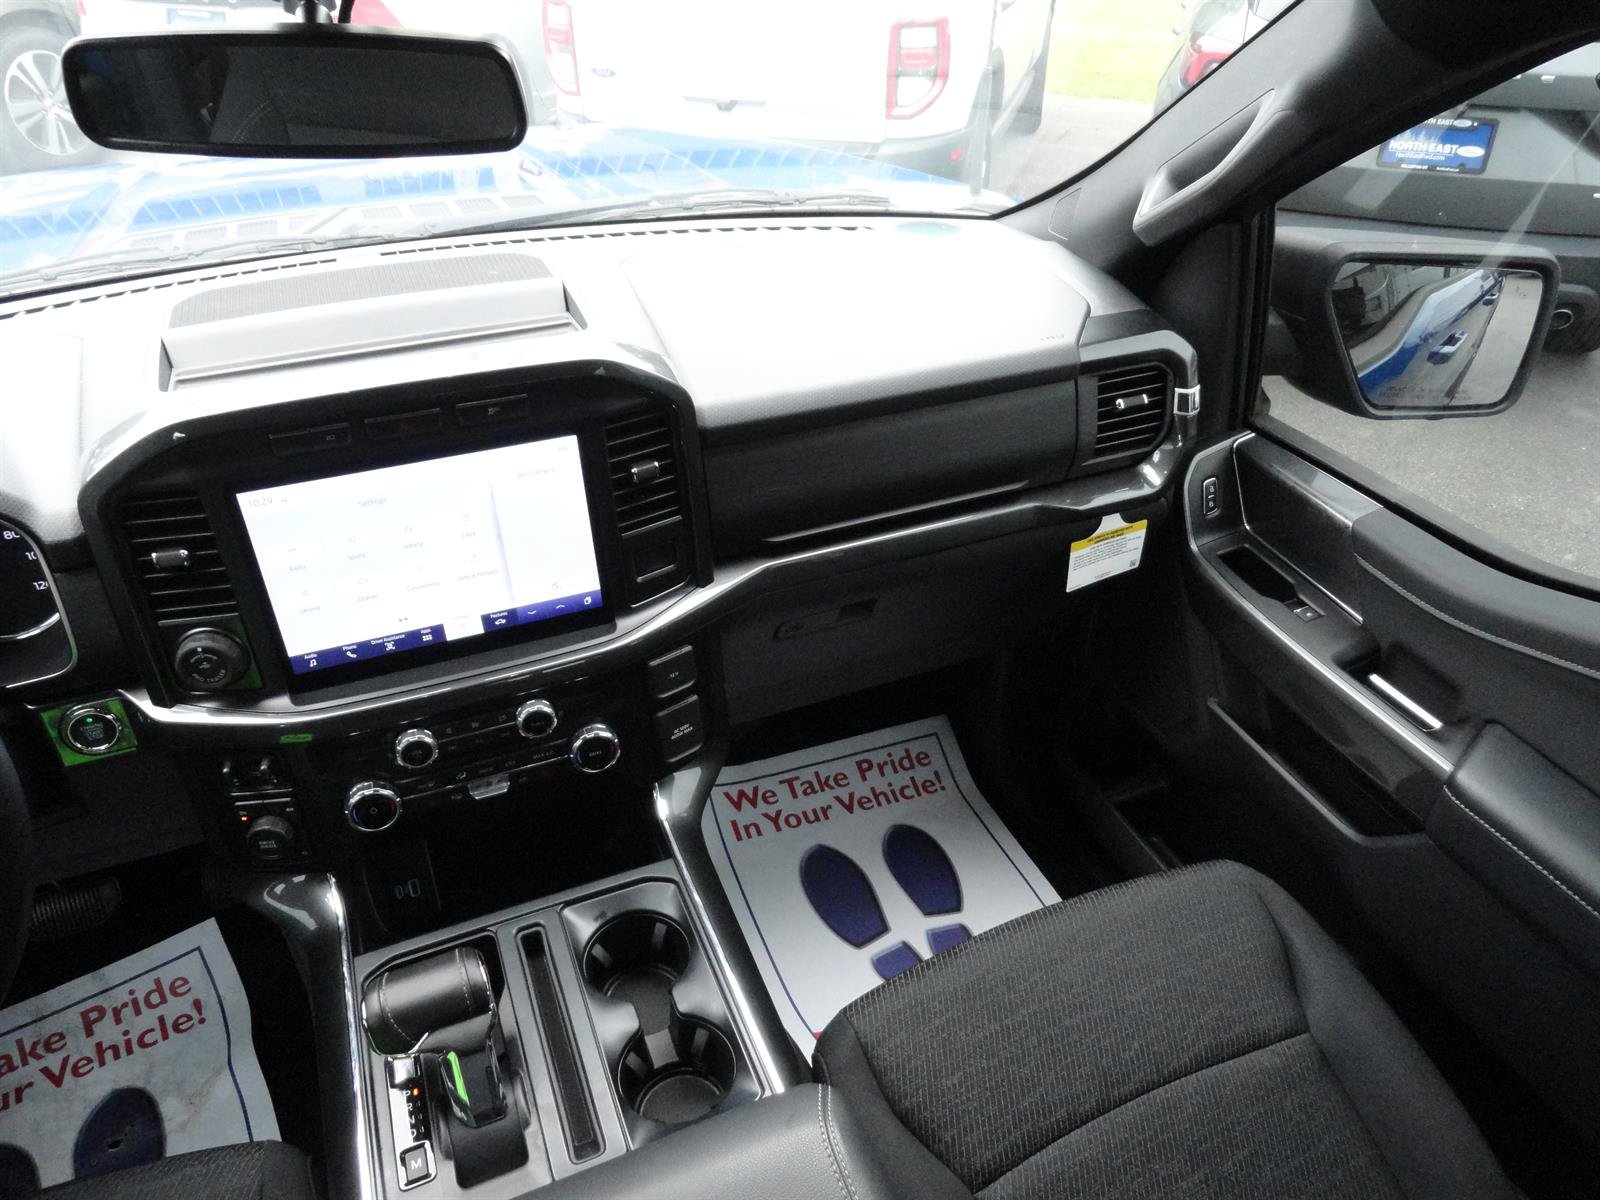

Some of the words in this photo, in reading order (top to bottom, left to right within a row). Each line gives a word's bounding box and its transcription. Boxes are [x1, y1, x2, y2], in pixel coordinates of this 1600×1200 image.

[1437, 118, 1454, 127] EAST
[723, 785, 779, 812] We
[780, 771, 850, 801] Take
[855, 747, 932, 783] Pride
[730, 817, 763, 842] In
[762, 805, 833, 833] Your
[833, 771, 946, 814] Vehicle!
[80, 976, 192, 1039] Pride
[39, 998, 206, 1089] Vehicle!
[411, 1158, 422, 1170] M
